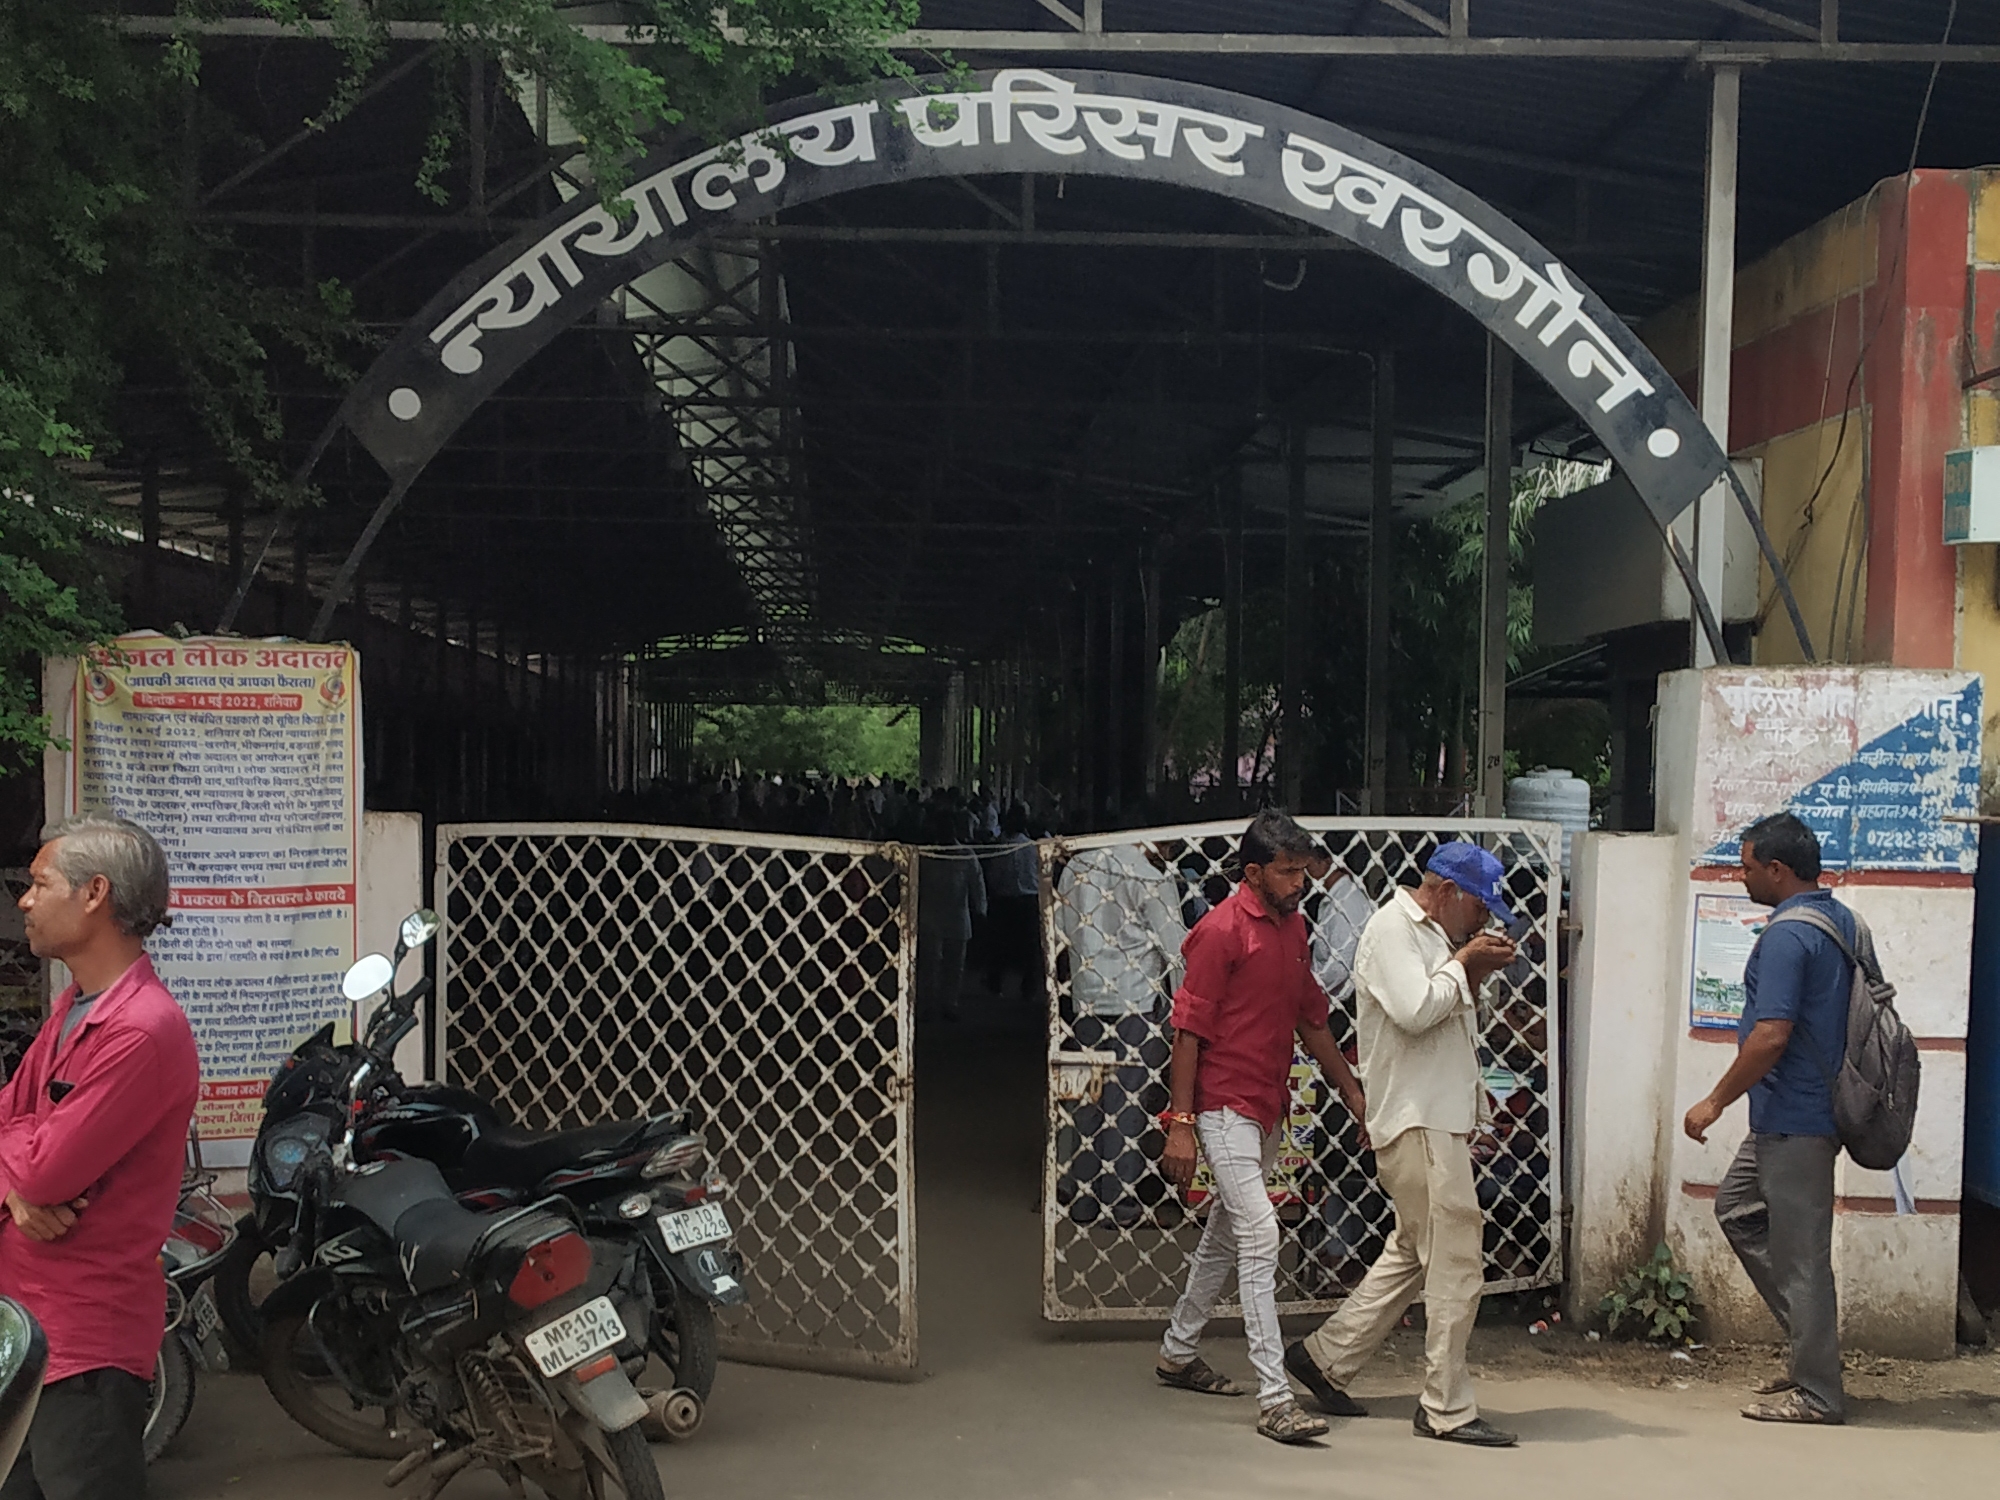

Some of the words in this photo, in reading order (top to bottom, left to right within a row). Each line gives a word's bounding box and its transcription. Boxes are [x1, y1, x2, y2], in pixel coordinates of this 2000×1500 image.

[428, 100, 878, 374] न्यायालय
[896, 68, 1265, 177] परिसर
[182, 641, 248, 668] लोक
[254, 649, 348, 669] अदालत
[174, 675, 217, 687] अदालत
[219, 673, 234, 688] एवं
[237, 676, 275, 688] आपका
[141, 694, 176, 706] दिनांक
[191, 695, 206, 706] 14
[208, 695, 223, 708] मई
[263, 694, 299, 708] शनिवार
[262, 714, 274, 726] को
[179, 750, 201, 761] लोक
[244, 763, 267, 774] लोक
[182, 894, 227, 907] प्रकरण
[230, 890, 245, 906] के
[672, 1213, 690, 1230] MP
[695, 1208, 713, 1225] 10
